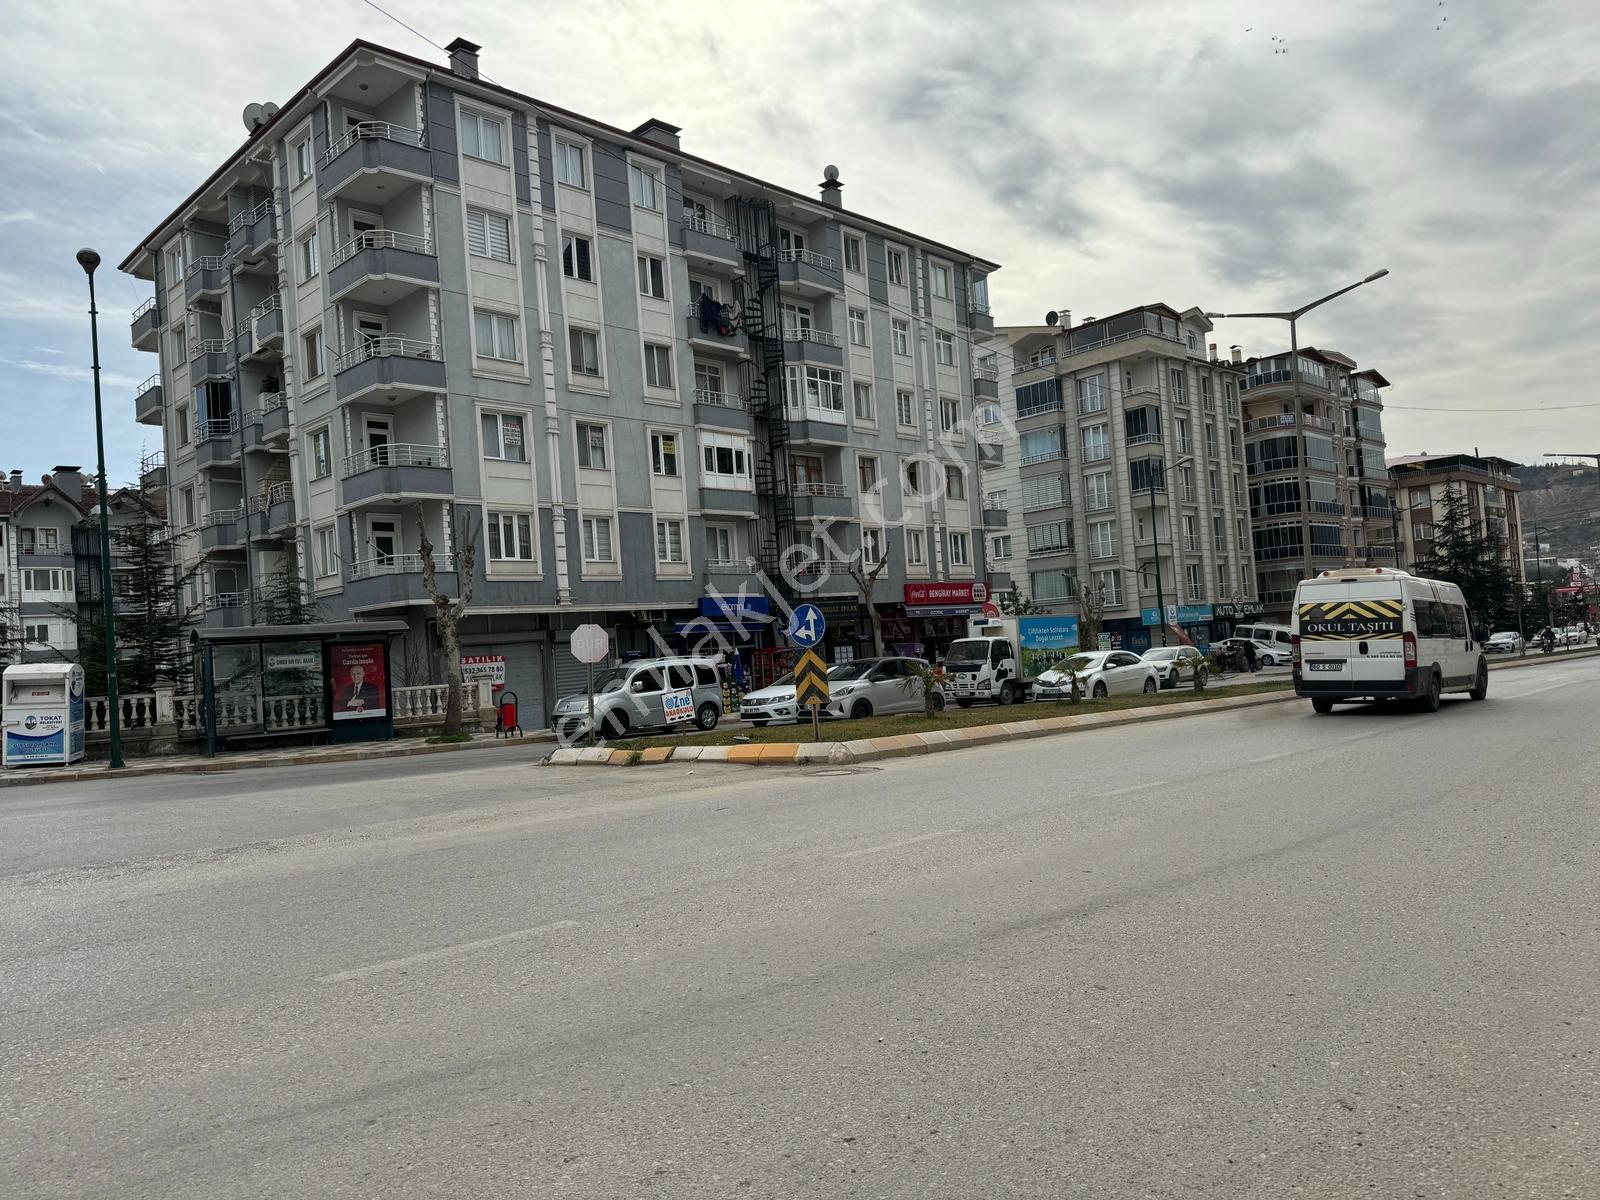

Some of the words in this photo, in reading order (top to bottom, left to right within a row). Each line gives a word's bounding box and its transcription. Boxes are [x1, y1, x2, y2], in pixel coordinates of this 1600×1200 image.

[952, 588, 970, 597] MARKET
[1216, 605, 1234, 616] AUTO
[1243, 604, 1265, 615] EMLAK
[1307, 623, 1345, 633] OKUL
[1348, 621, 1393, 633] TAŞITI
[460, 655, 503, 664] SATILIK
